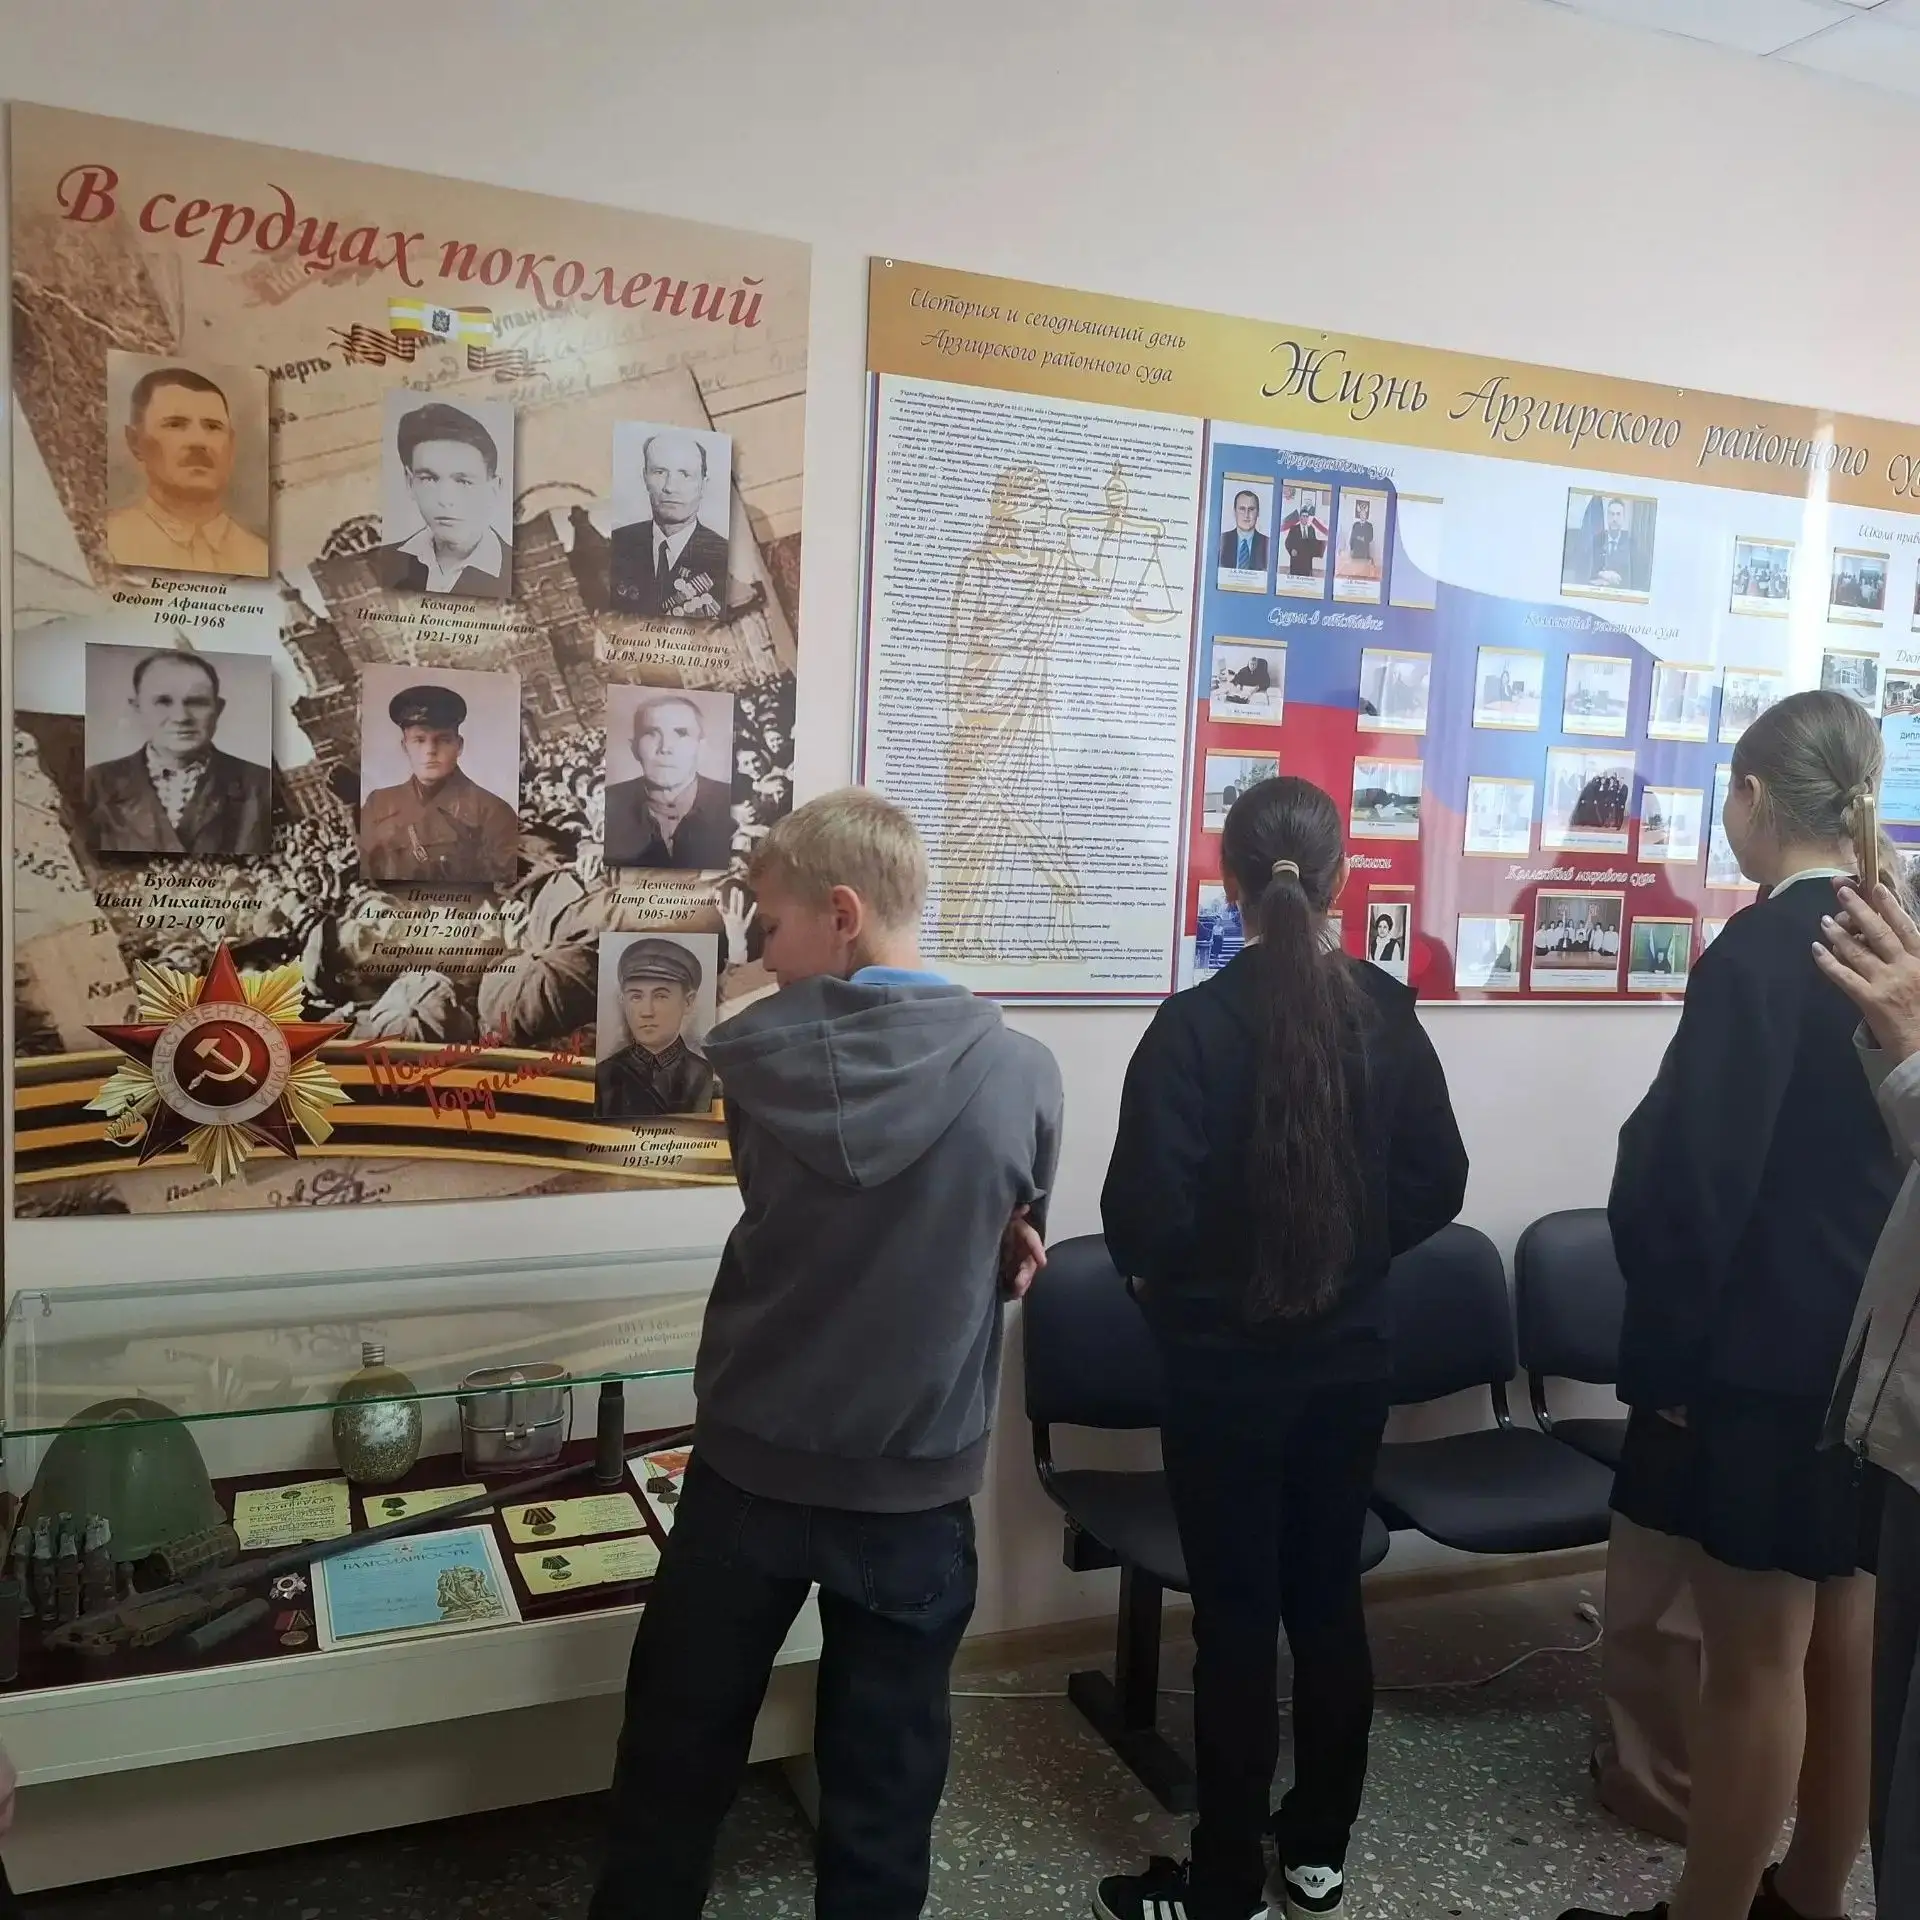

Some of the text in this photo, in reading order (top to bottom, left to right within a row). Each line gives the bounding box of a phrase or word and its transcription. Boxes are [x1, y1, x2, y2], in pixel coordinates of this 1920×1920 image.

[56, 163, 767, 328] В сердцах поколений
[910, 287, 1187, 349] История и сегодняшний день
[920, 328, 1173, 385] Арзгирского районного суда
[255, 357, 332, 385] мерть
[1261, 341, 1429, 421] Жизнь
[1448, 376, 1682, 450] Арзгирского
[1696, 424, 1869, 476] районного
[151, 576, 227, 595] Бережной
[112, 591, 264, 615] Федот Афанасьевич
[420, 598, 476, 615] Комаров
[154, 612, 225, 628] 1900-1968
[356, 608, 537, 634] Николай Константинович
[415, 629, 480, 645] 1921-1981
[640, 622, 696, 636] Левченко
[606, 634, 729, 654] Леонид Михайлович
[144, 873, 217, 891] Будяков
[636, 878, 696, 891] Демченко
[94, 893, 263, 911] Иван Михайлович
[610, 894, 721, 907] Петр Самойлович
[136, 914, 226, 930] 1912-1970
[360, 907, 516, 923] Александр Иванович
[637, 909, 696, 921] 1905-1987
[405, 925, 479, 938] 1917-2001
[372, 942, 504, 958] Гвардии капитан
[358, 961, 516, 976] командир батальона
[631, 1125, 677, 1139] Чупряк
[585, 1139, 718, 1154] Филипп Стефанович
[621, 1155, 682, 1168] 1913-1947
